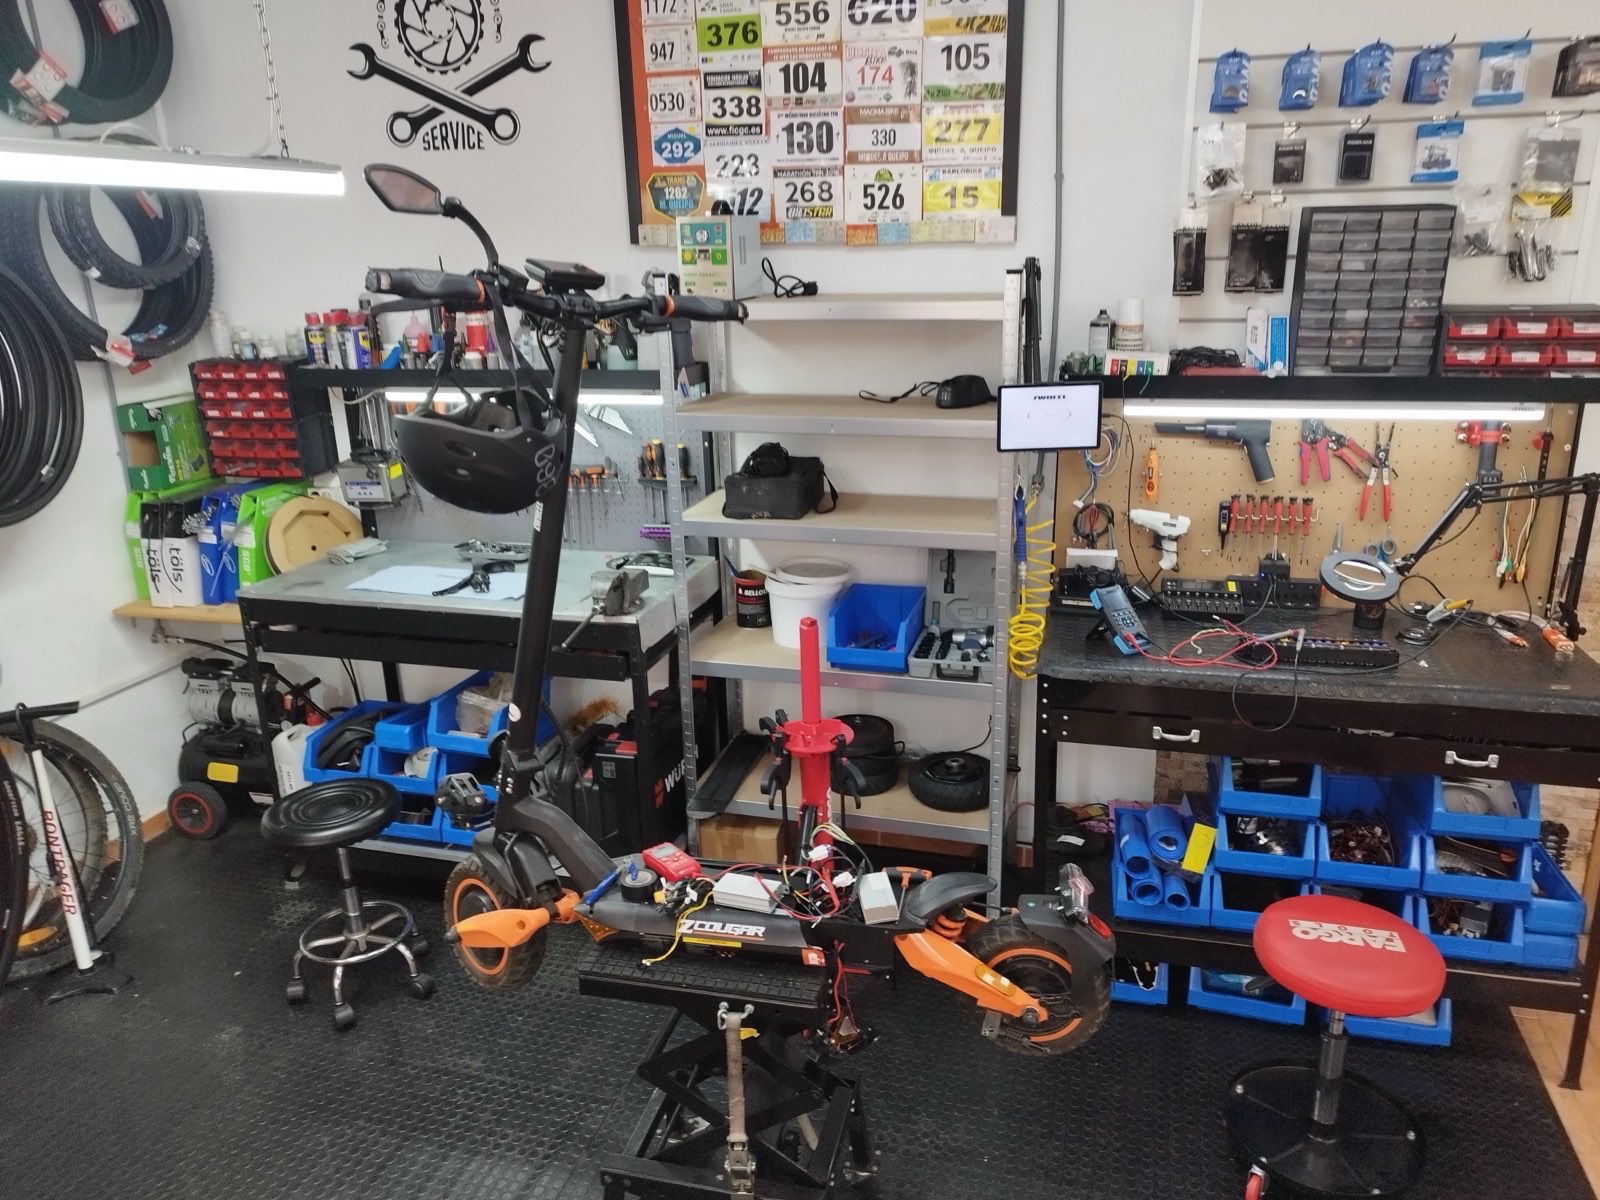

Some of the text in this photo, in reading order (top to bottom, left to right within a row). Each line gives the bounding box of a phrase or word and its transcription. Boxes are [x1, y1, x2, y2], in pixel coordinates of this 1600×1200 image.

[775, 1, 830, 26] 556
[707, 21, 759, 47] 376
[650, 42, 675, 61] 947
[941, 43, 990, 71] 105
[779, 62, 827, 94] 104
[857, 65, 894, 85] 174
[650, 92, 685, 112] 0530
[712, 95, 761, 118] 338
[422, 121, 486, 151] SERVICE
[782, 121, 834, 155] 130
[872, 129, 896, 146] 330
[934, 118, 991, 143] 277
[661, 141, 695, 158] 292
[715, 153, 760, 178] 223
[664, 186, 688, 200] 1262
[785, 181, 834, 203] 268
[863, 183, 905, 211] 526
[944, 185, 979, 209] 15
[169, 547, 184, 582] töls
[42, 810, 78, 915] BONTRAGER
